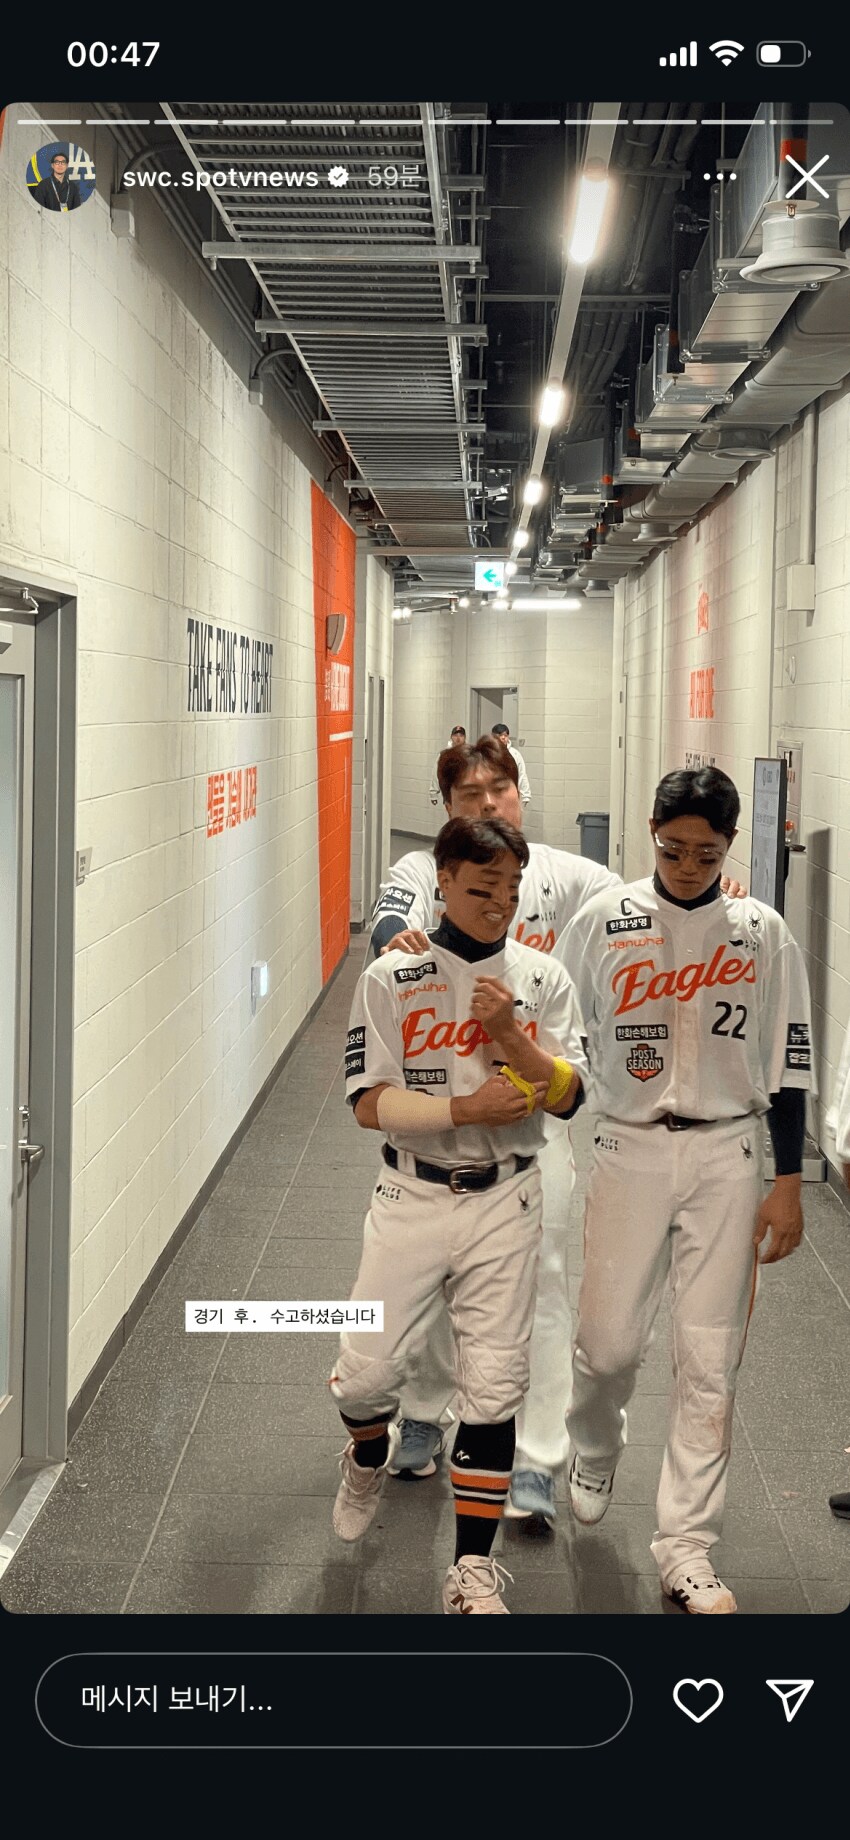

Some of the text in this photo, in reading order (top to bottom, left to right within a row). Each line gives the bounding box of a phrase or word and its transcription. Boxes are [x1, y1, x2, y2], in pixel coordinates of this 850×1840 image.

[187, 617, 213, 712] TAKE
[215, 627, 237, 713] FANS
[240, 635, 250, 713] TO
[250, 639, 273, 713] HEART
[620, 897, 632, 916] C
[609, 917, 648, 931] 한화생명
[608, 936, 664, 950] Hanwha
[612, 944, 756, 1017] Eagles
[711, 1001, 748, 1040] 22
[616, 1026, 667, 1039] 한화손해보험
[632, 1049, 654, 1059] POST
[627, 1059, 662, 1070] SEASON
